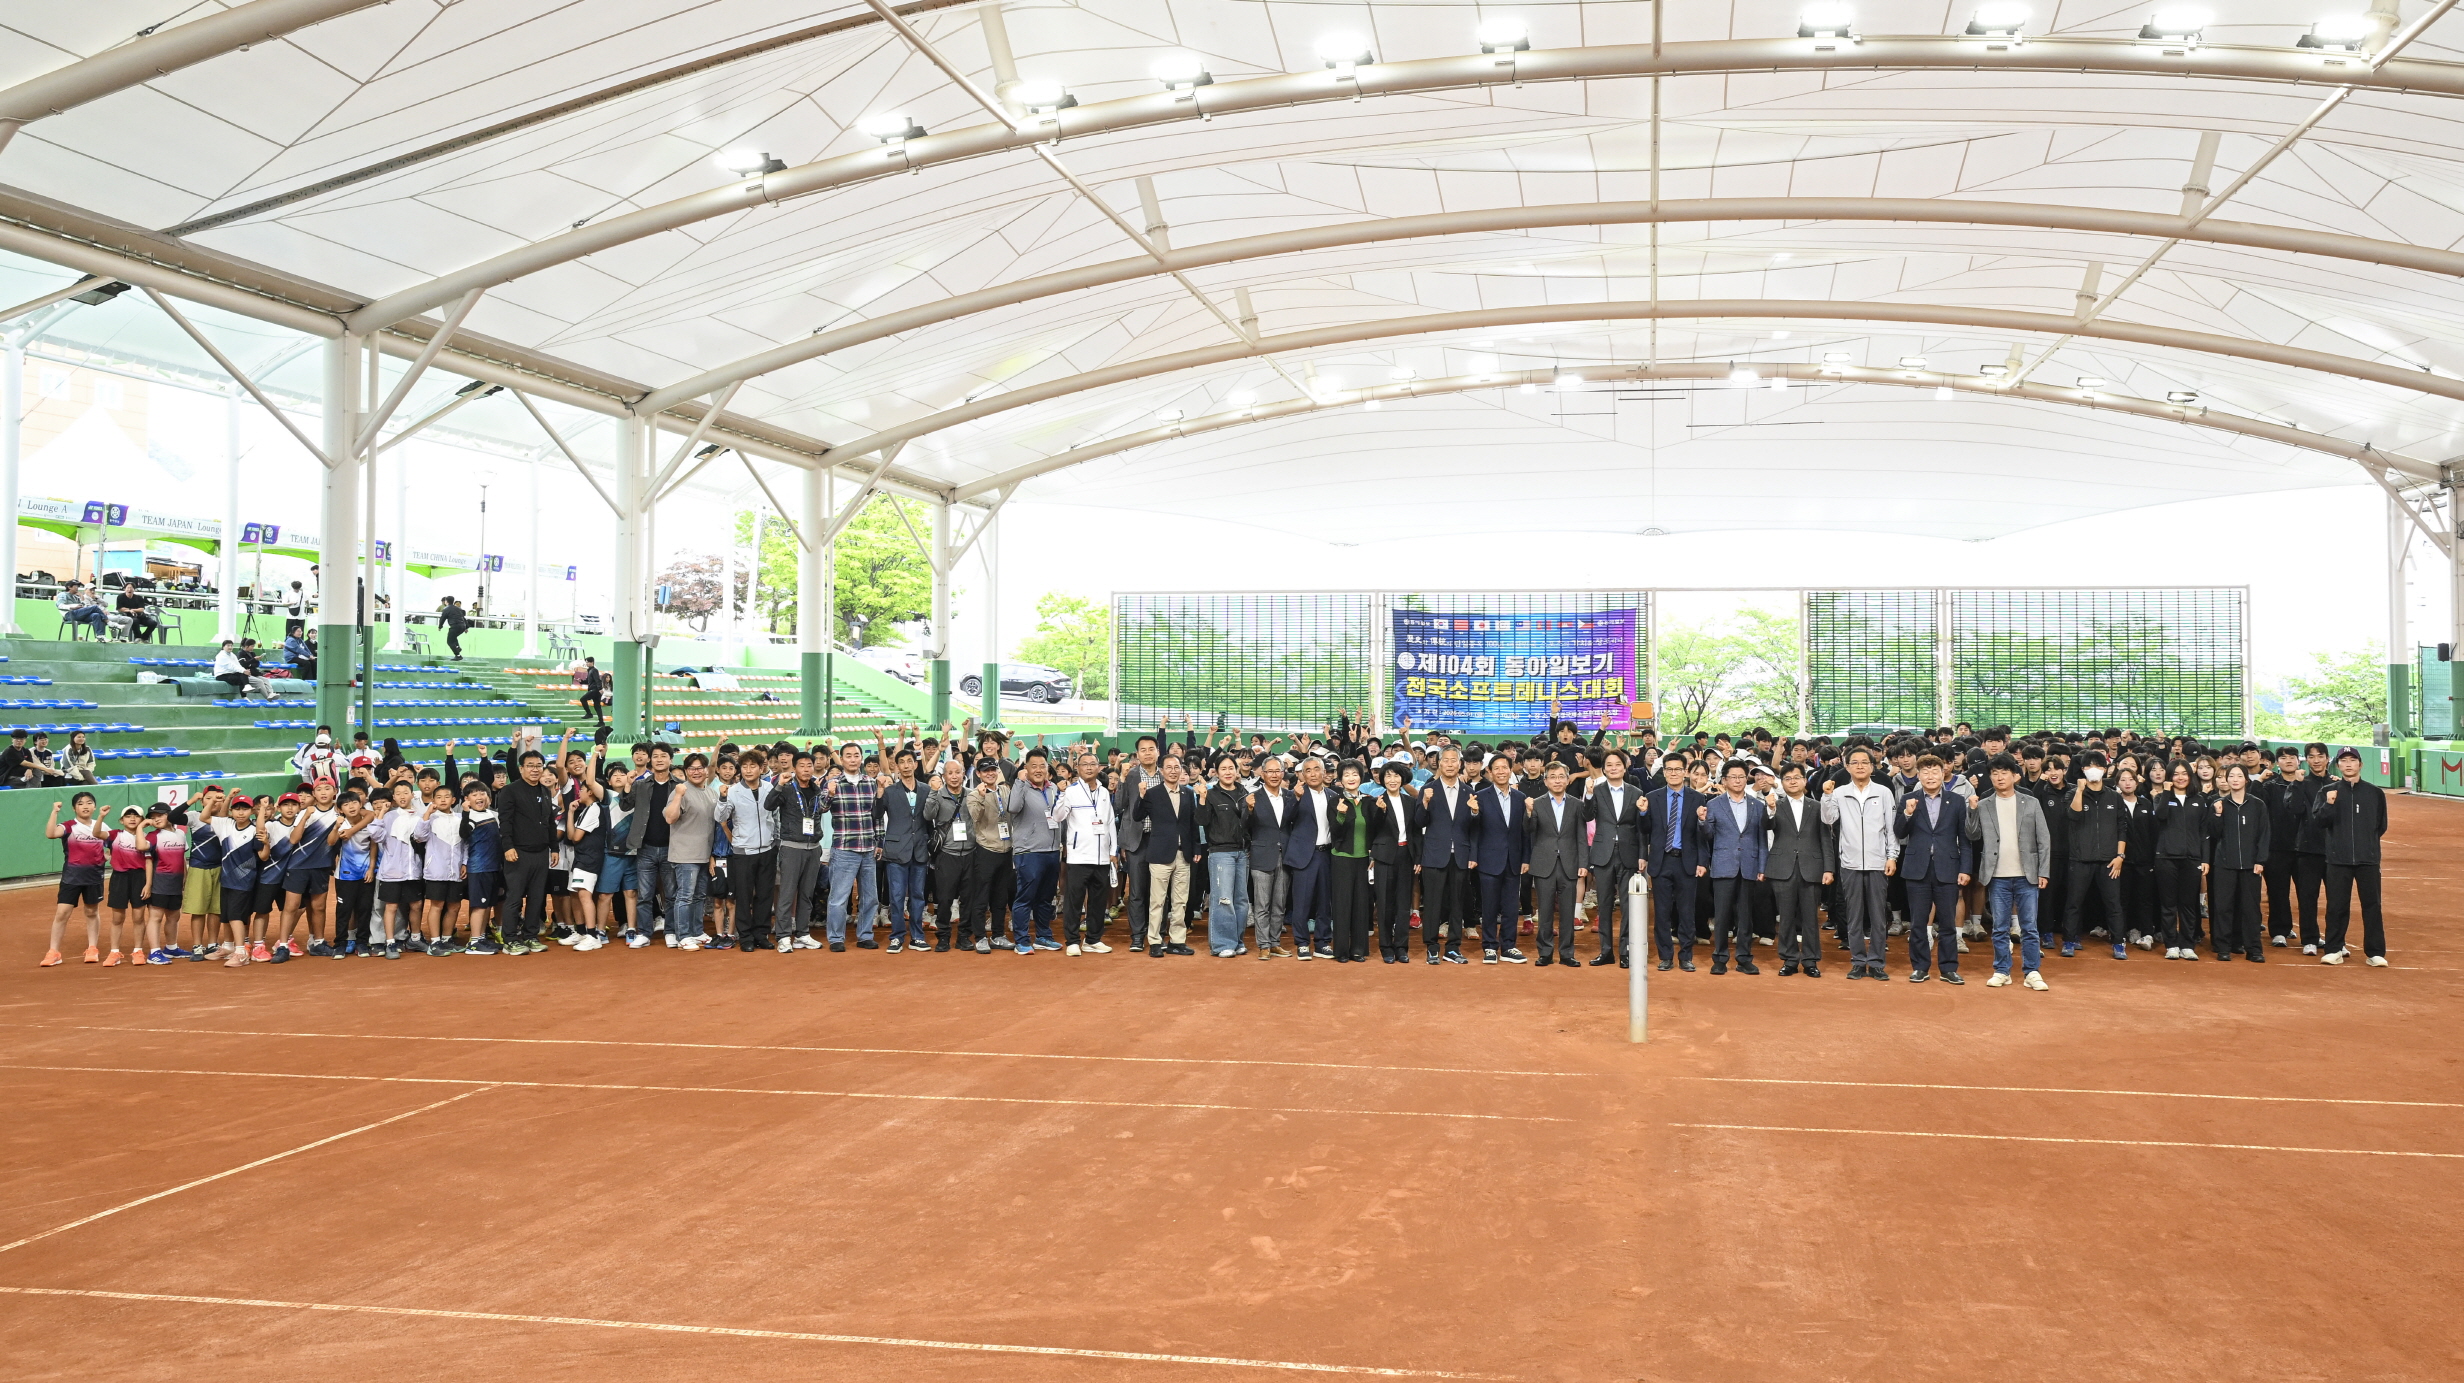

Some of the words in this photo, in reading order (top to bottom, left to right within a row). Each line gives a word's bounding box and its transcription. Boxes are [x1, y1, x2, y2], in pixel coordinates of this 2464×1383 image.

[27, 500, 58, 512] Lounge
[61, 504, 68, 513] A
[142, 515, 165, 526] TEAM
[167, 518, 193, 529] JAPAN
[291, 534, 309, 544] TEAM
[413, 551, 428, 560] TEAM
[430, 554, 447, 562] CHINA
[449, 556, 466, 565] Lounge
[1417, 652, 1495, 677] 제104회
[1504, 652, 1614, 678] 동아일보기
[1406, 676, 1623, 702] 전국소프트테니스대회
[169, 789, 178, 807] 2
